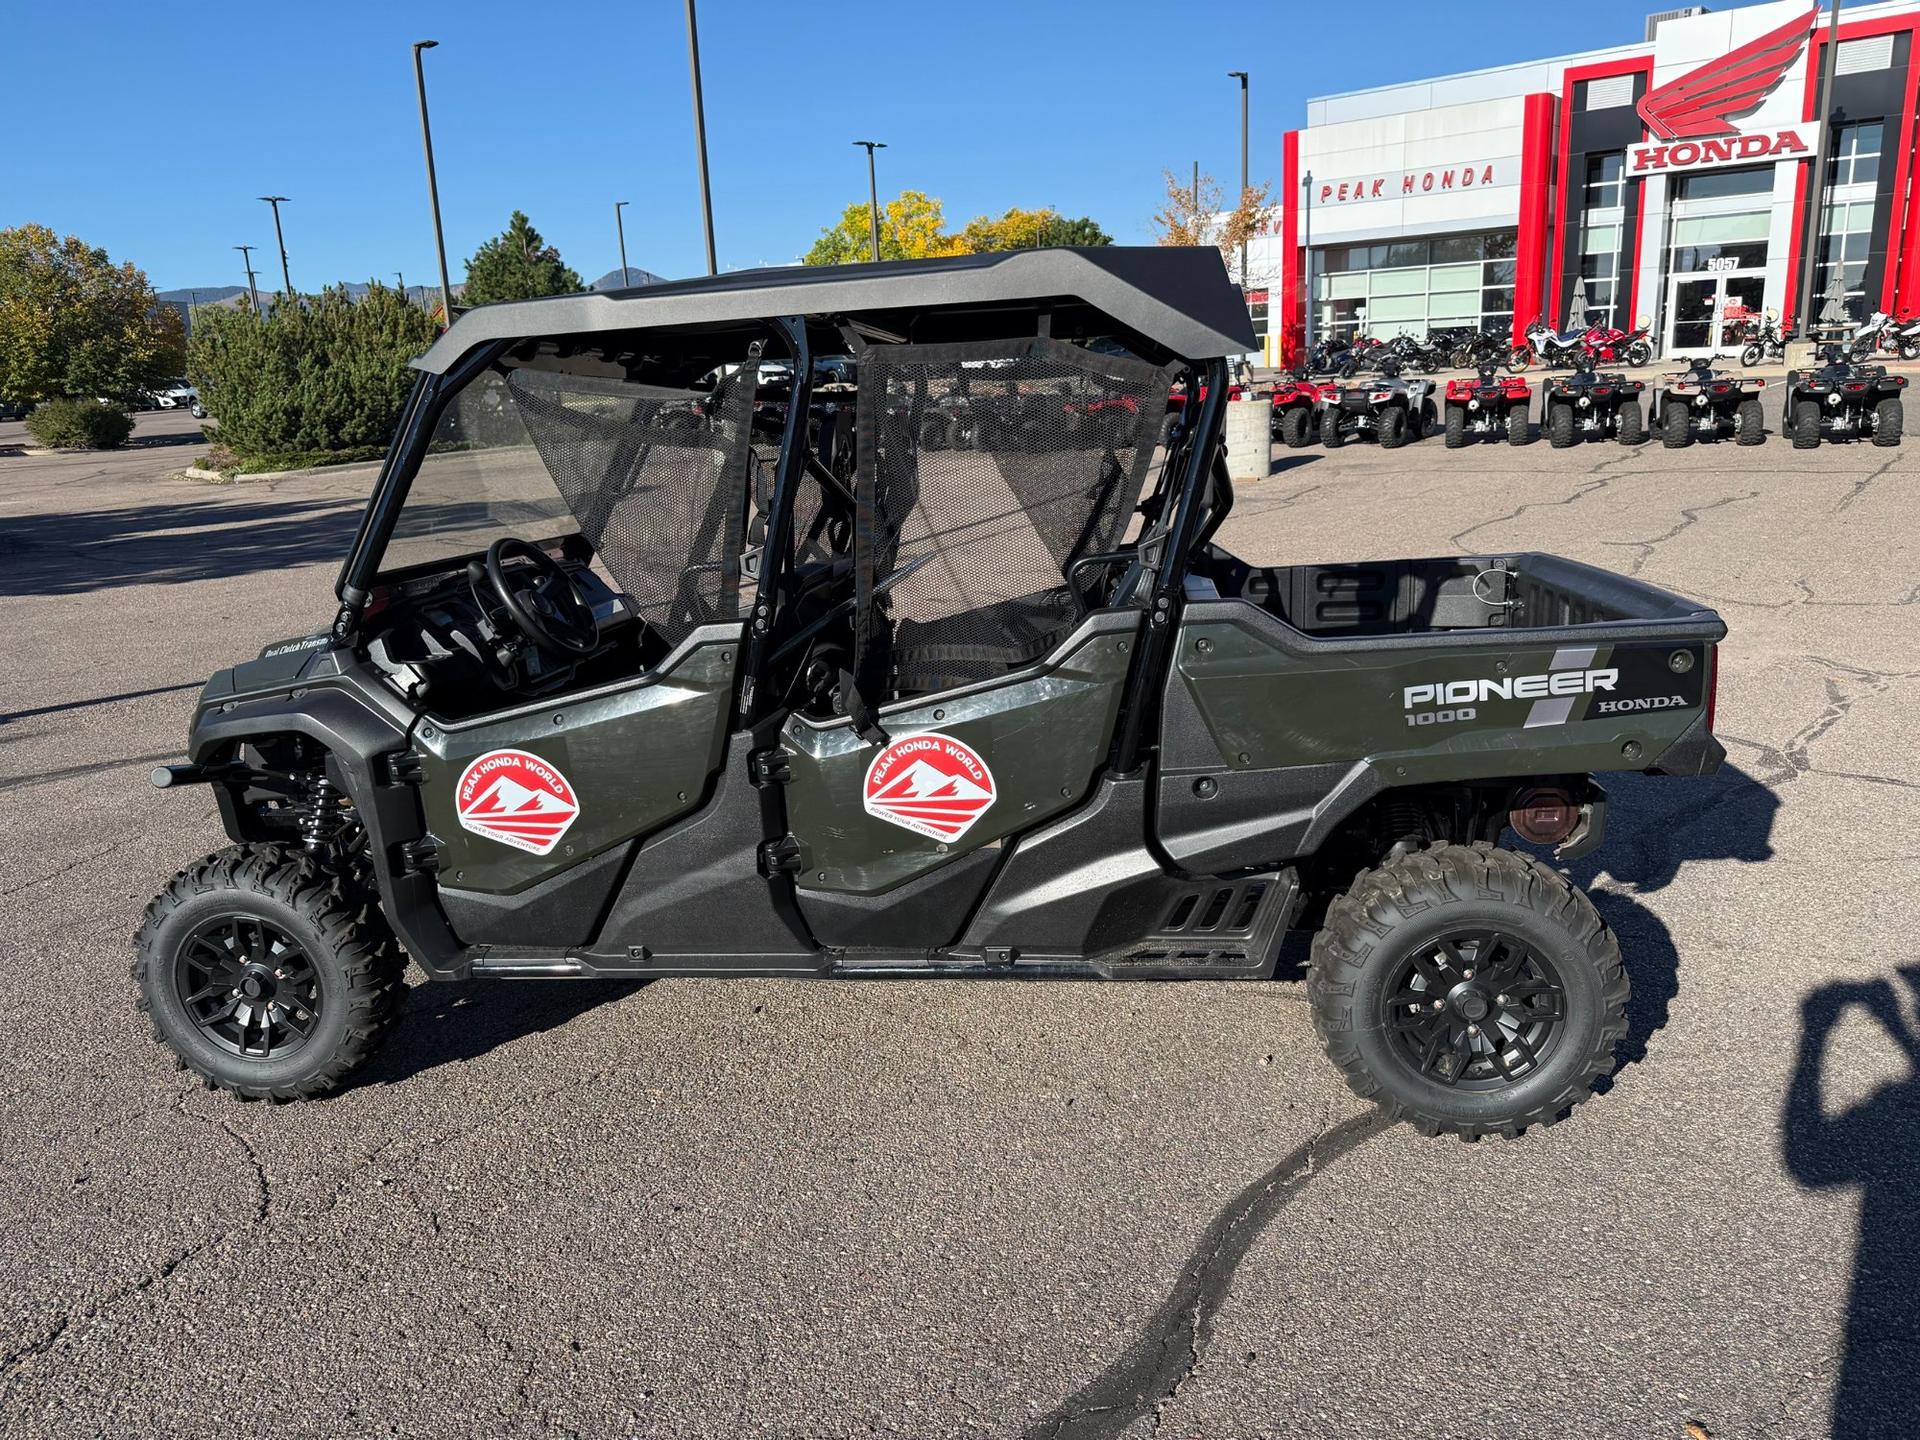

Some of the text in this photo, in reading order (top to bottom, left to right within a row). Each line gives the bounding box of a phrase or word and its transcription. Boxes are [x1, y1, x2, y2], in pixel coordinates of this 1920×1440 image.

[1633, 130, 1809, 171] HONDA
[1321, 165, 1493, 203] PEAK HONDA
[1707, 257, 1740, 271] 5057
[265, 647, 280, 658] Dual
[280, 642, 300, 655] Clutch
[1404, 668, 1619, 709] PIONEER
[1598, 695, 1688, 713] HONDA
[1405, 708, 1476, 726] 1000
[463, 757, 564, 801] PEAK HONDA WORLD
[873, 740, 983, 785] PEAK HONDA WORLD
[464, 822, 540, 852] POWER YOUR ADVENTURE
[870, 807, 949, 840] POWER YOUR ADVENTURE
